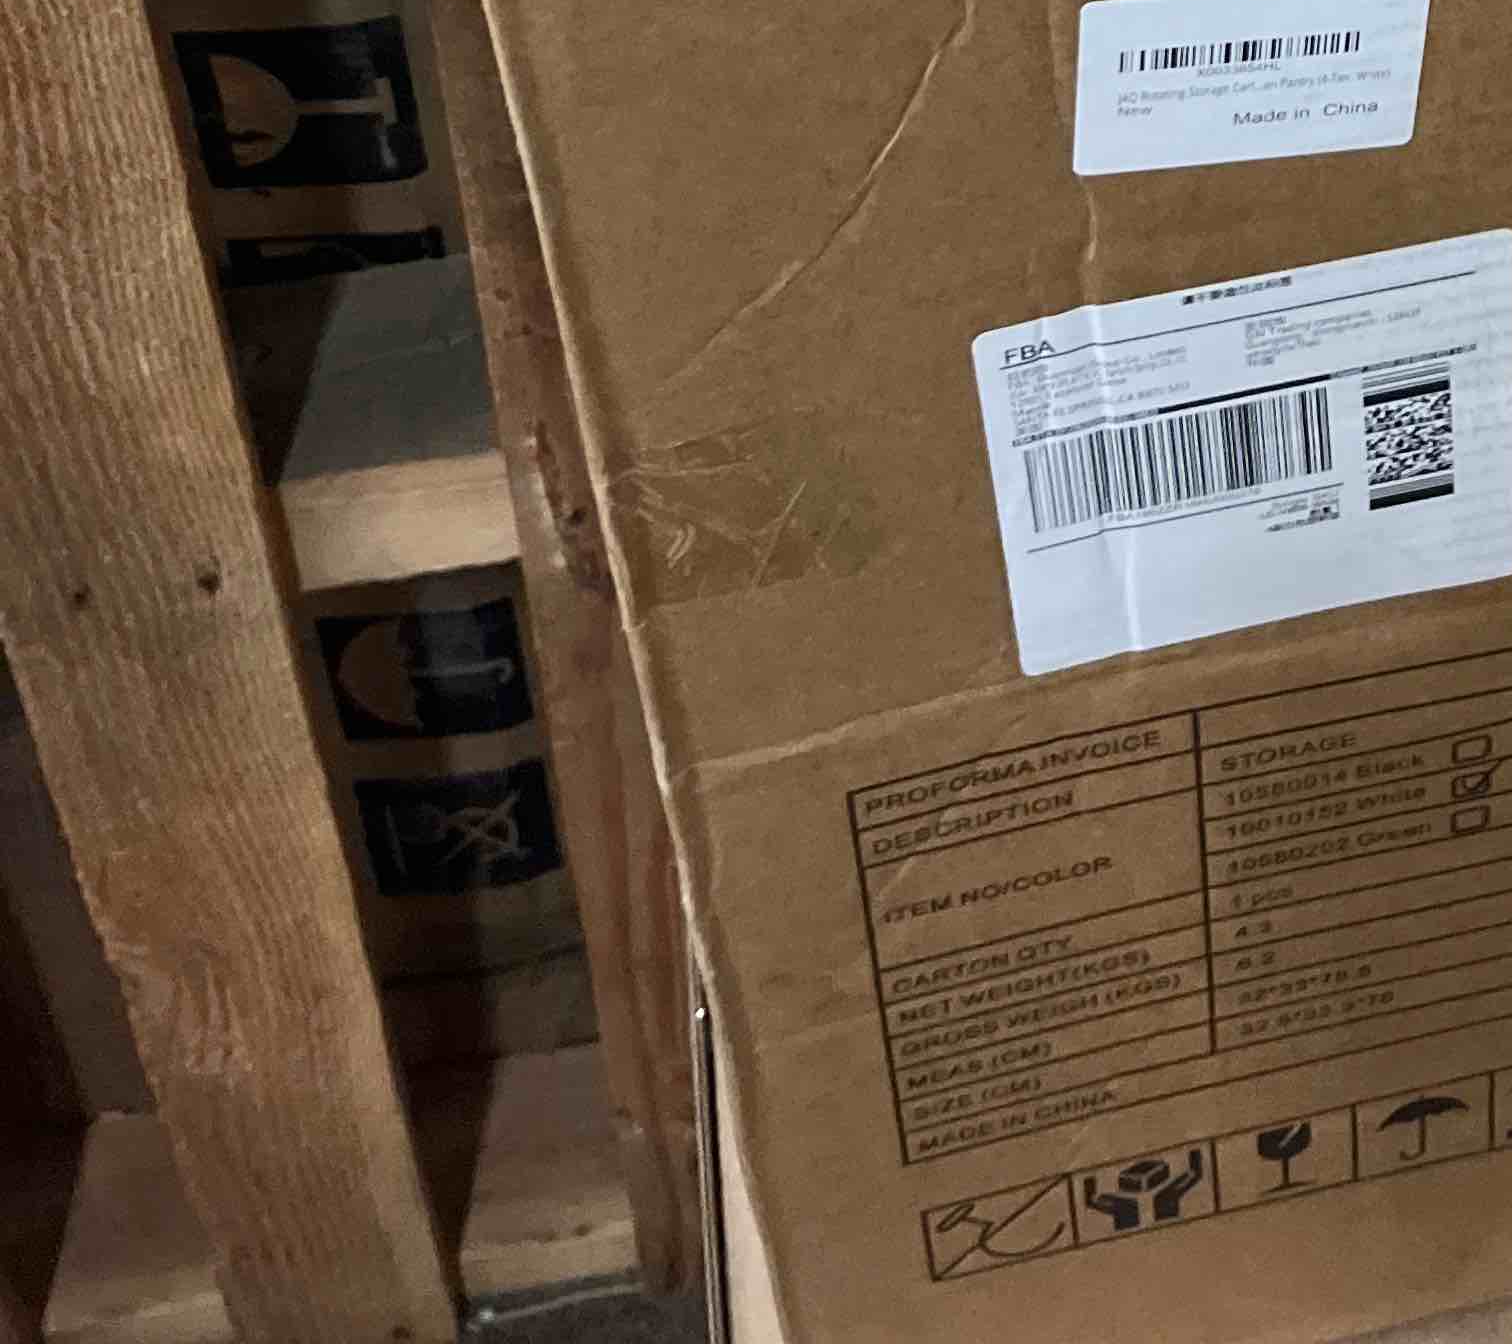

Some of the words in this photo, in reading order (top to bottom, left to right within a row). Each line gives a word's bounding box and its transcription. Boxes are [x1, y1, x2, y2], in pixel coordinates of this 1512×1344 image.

[1232, 111, 1288, 127] Made
[1294, 108, 1310, 121] in
[1323, 101, 1379, 117] China
[1003, 339, 1056, 364] FBA
[864, 758, 1036, 814] PROFORMA
[1038, 729, 1162, 771] INVOICE
[1220, 732, 1358, 772] STORAGE
[1355, 753, 1425, 780] Black
[1356, 786, 1427, 810] White
[872, 790, 1074, 855] DESCRIPTION
[1356, 822, 1433, 847] Green
[881, 895, 950, 924] ITEM
[959, 856, 1113, 905] NO/COLOR
[892, 952, 1009, 994] CARTON
[1017, 934, 1073, 961] QTY
[899, 998, 954, 1023] NET
[901, 1018, 998, 1057] GROSS
[906, 1058, 983, 1090] MEAS
[991, 1041, 1052, 1068] (CM)
[914, 1093, 975, 1121] SIZE
[981, 1078, 1042, 1102] (CM)
[918, 1122, 996, 1153] MADE
[1001, 1112, 1028, 1129] IN
[1034, 1089, 1118, 1120] CHINA
